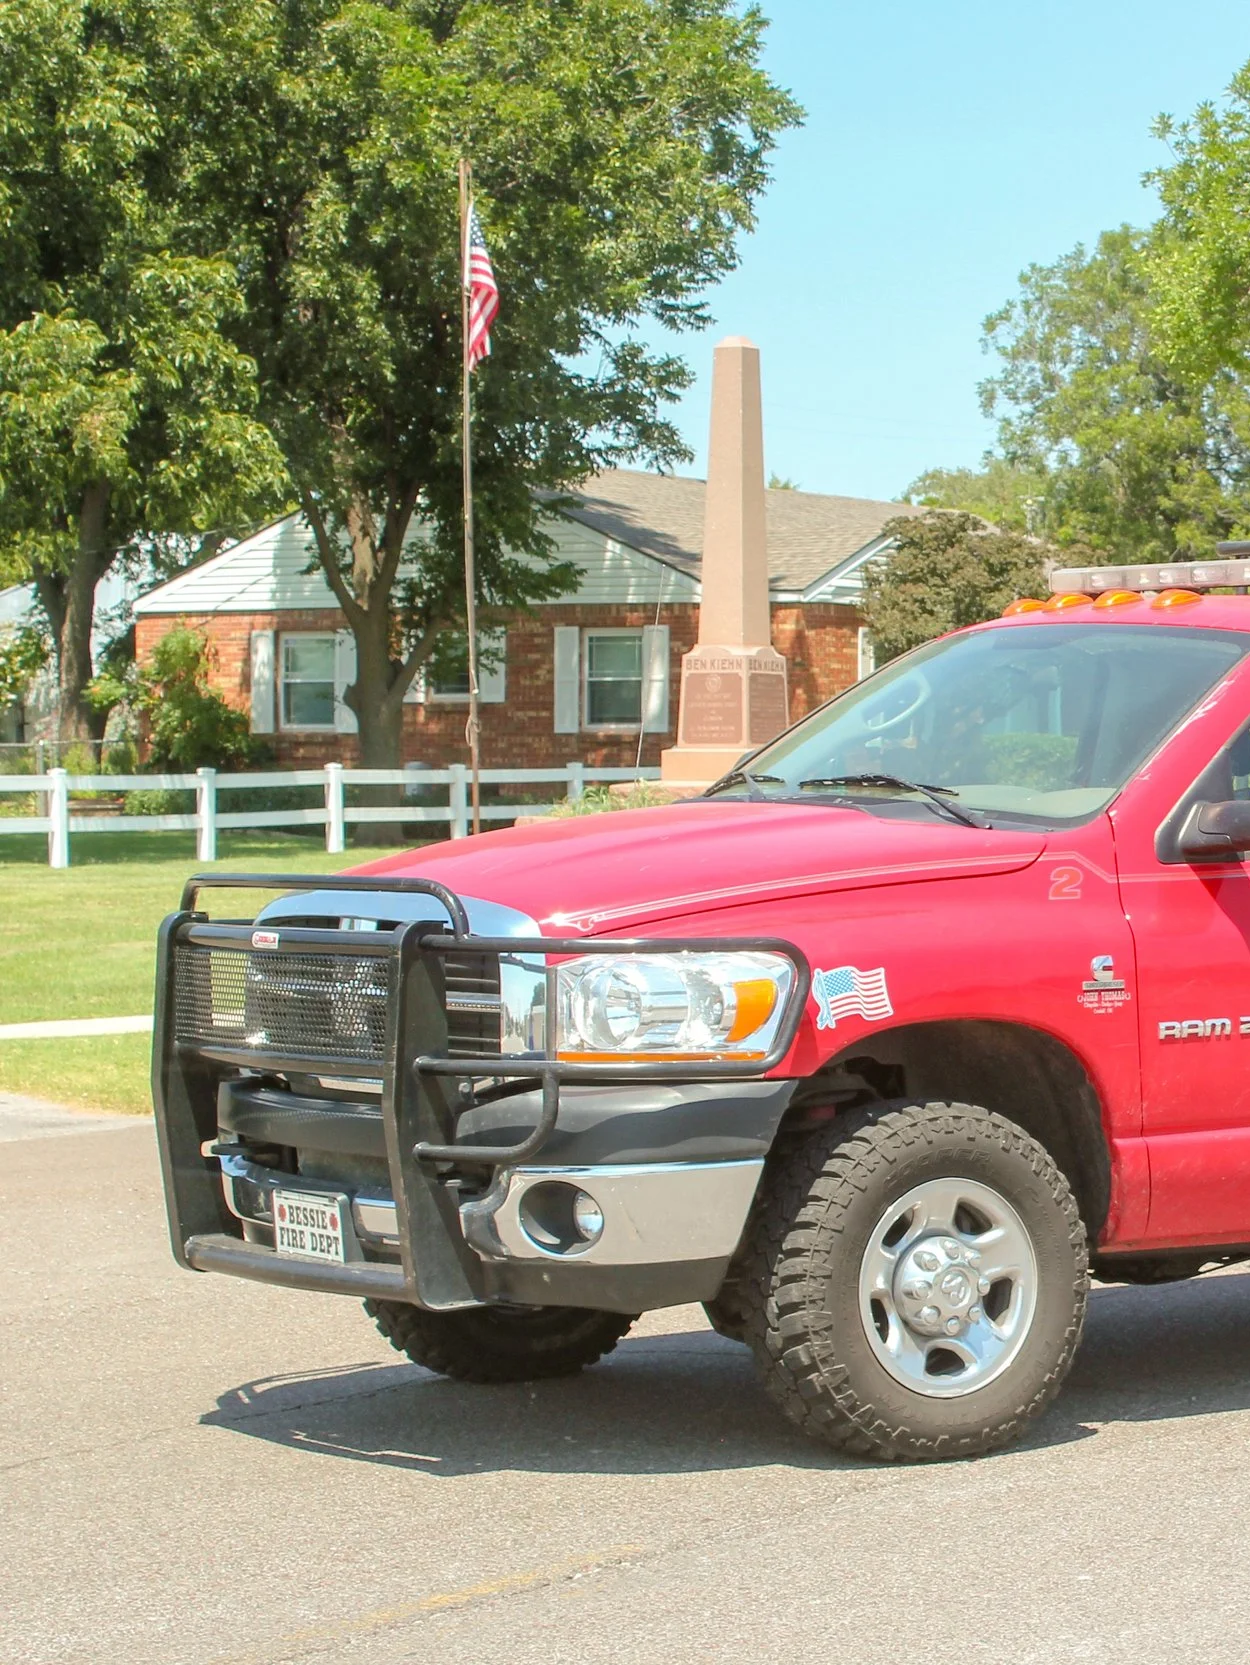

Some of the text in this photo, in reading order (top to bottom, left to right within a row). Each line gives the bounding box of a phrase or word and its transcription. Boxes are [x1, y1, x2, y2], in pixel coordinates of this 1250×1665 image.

[685, 659, 742, 671] BEN KIEHN
[1048, 866, 1084, 900] 2
[1158, 1018, 1231, 1040] RAM
[288, 1205, 328, 1230] BESSIE
[279, 1226, 340, 1256] FIRE DEPT
